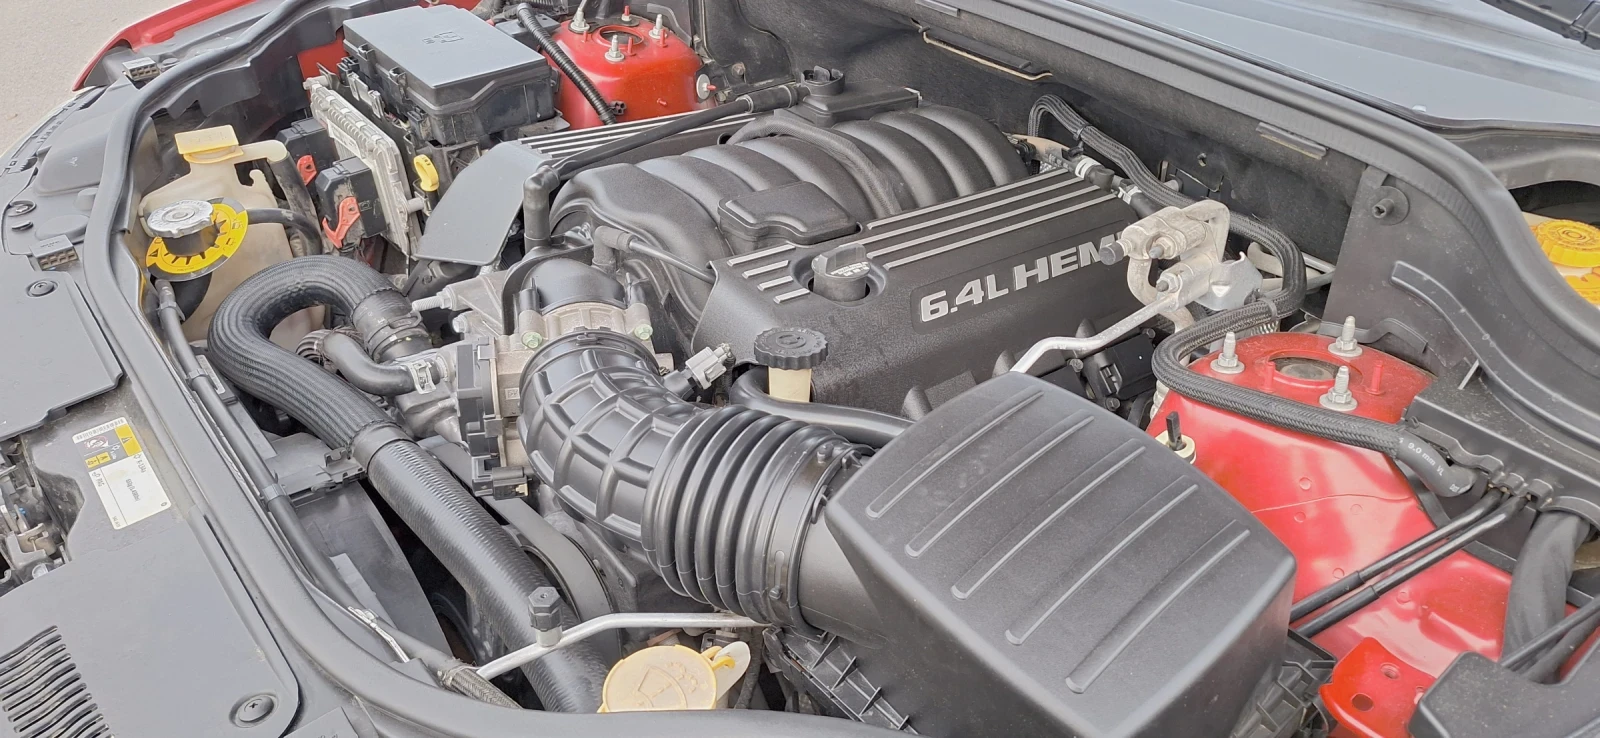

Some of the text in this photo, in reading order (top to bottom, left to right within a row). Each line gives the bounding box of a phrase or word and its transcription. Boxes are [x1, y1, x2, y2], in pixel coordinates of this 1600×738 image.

[920, 231, 1123, 323] 6.4L HEM
[1422, 453, 1436, 466] mm
